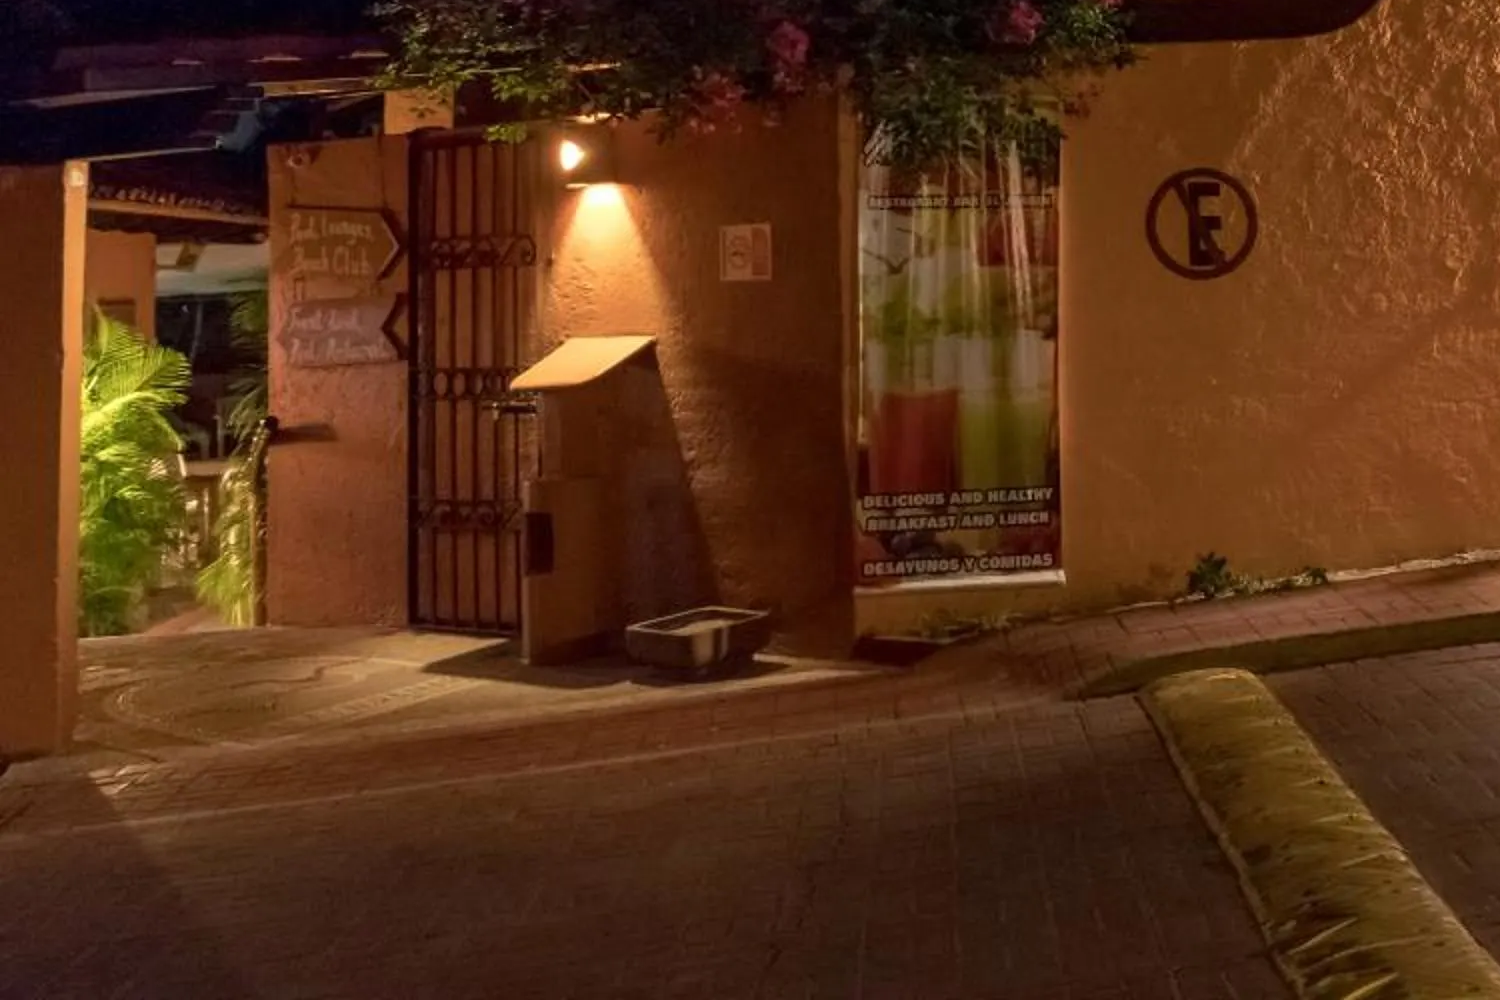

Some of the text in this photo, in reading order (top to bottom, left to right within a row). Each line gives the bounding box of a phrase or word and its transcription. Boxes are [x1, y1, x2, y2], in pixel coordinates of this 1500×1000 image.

[863, 487, 1053, 508] DELICIOUS AND HEALTHY
[867, 511, 1050, 532] BREAKFAST AND LUNCH
[863, 553, 1054, 577] DESAYUNOS Y COMIDAS
